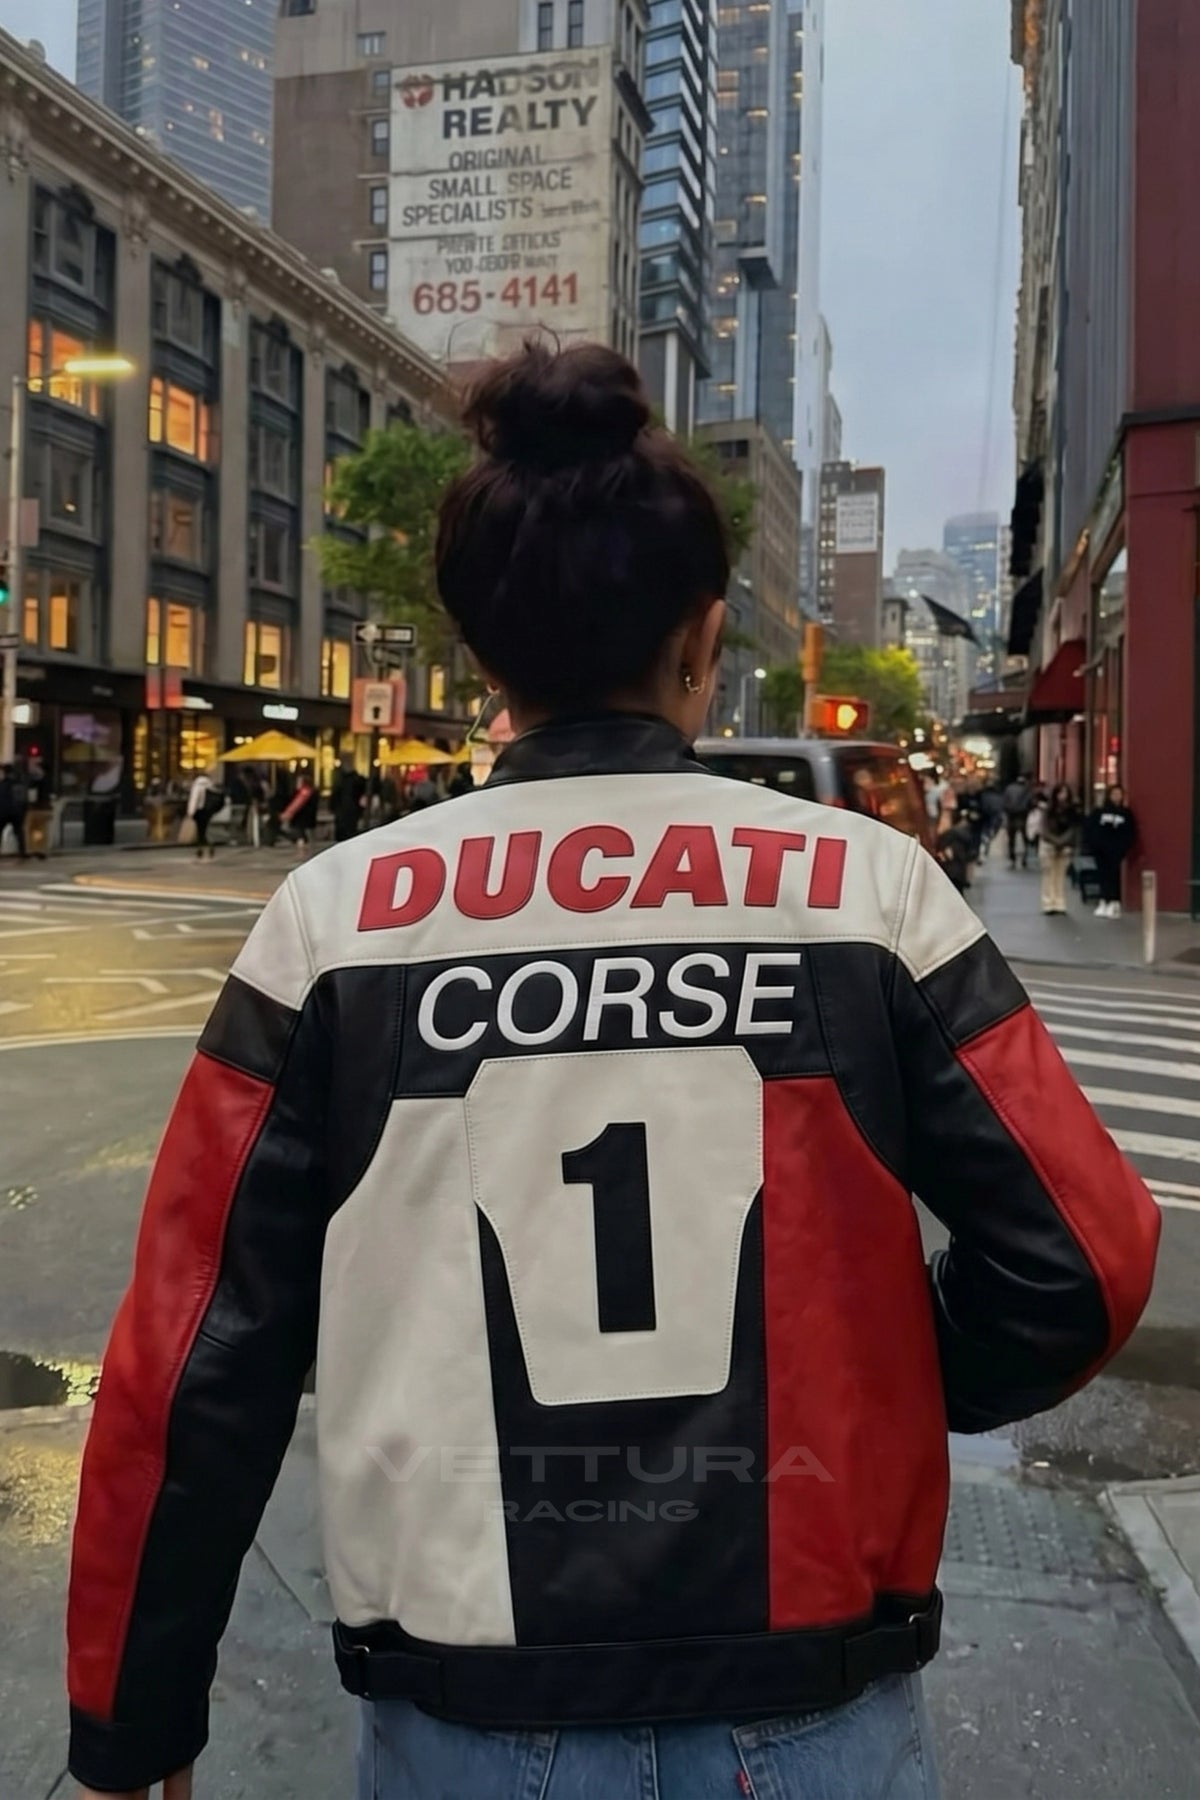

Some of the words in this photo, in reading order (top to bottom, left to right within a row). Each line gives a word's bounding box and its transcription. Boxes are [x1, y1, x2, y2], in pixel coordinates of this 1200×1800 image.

[443, 96, 597, 139] REALTY
[450, 145, 547, 172] ORIGINAL
[429, 175, 497, 200] SMALL
[507, 167, 572, 195] SPACE
[402, 197, 533, 227] SPECIALISTS
[413, 271, 578, 315] 685-4141
[357, 824, 846, 932] DUCATI
[417, 952, 801, 1051] CORSE
[561, 1122, 657, 1333] 1
